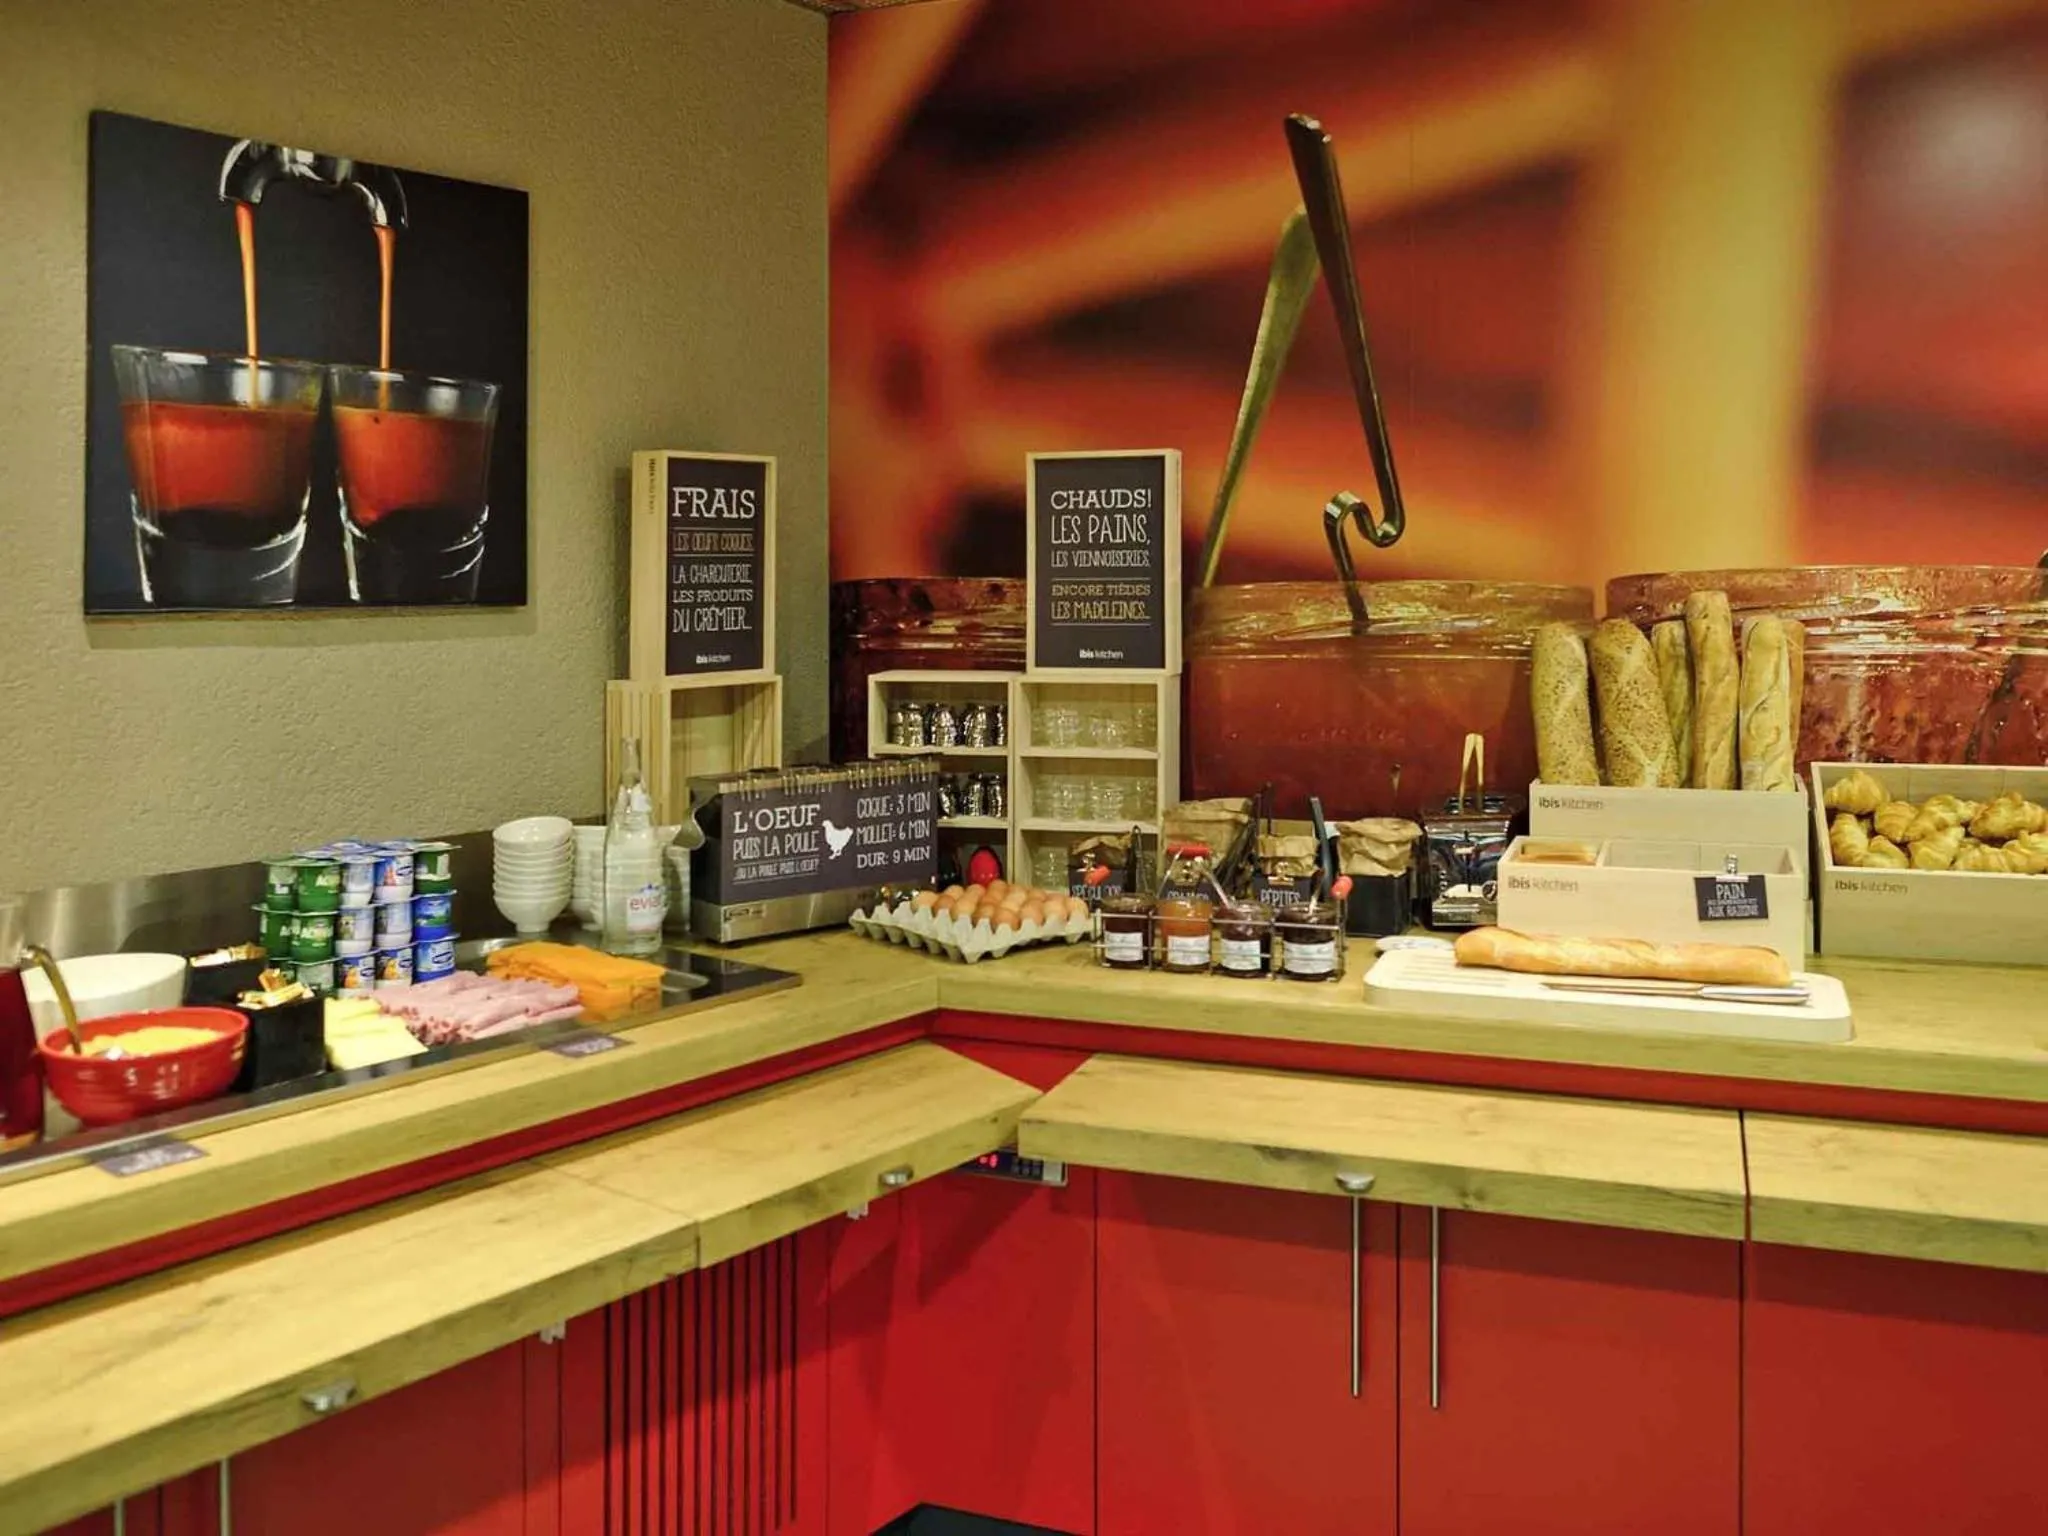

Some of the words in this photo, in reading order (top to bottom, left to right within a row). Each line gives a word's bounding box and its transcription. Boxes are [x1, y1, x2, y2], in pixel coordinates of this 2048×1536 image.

[672, 487, 755, 519] FRAIS
[1051, 489, 1151, 509] CHAUDS!
[1052, 515, 1081, 544] LES
[1088, 514, 1151, 545] PAINS,
[673, 533, 689, 551] LES
[1051, 550, 1068, 567] LES
[672, 564, 687, 584] LA
[672, 590, 695, 602] LES
[697, 589, 753, 602] PRODUITS
[1052, 584, 1104, 596] ENCORE
[673, 608, 691, 632] DU
[1051, 601, 1070, 619] LES
[857, 795, 894, 818] COQUE:
[896, 793, 905, 815] 3
[907, 791, 931, 814] MIN
[1539, 798, 1560, 808] ibis
[733, 803, 821, 833] L'OEUF
[899, 820, 906, 840] 6
[908, 818, 931, 840] MIN
[733, 837, 760, 861] PUIS
[764, 835, 780, 857] LA
[784, 830, 820, 856] POULE
[856, 851, 890, 869] DUR:
[892, 849, 901, 864] 9
[904, 845, 931, 863] MIN
[1508, 876, 1530, 888] ibis
[1716, 883, 1746, 900] PAIN
[1835, 880, 1859, 891] ibis
